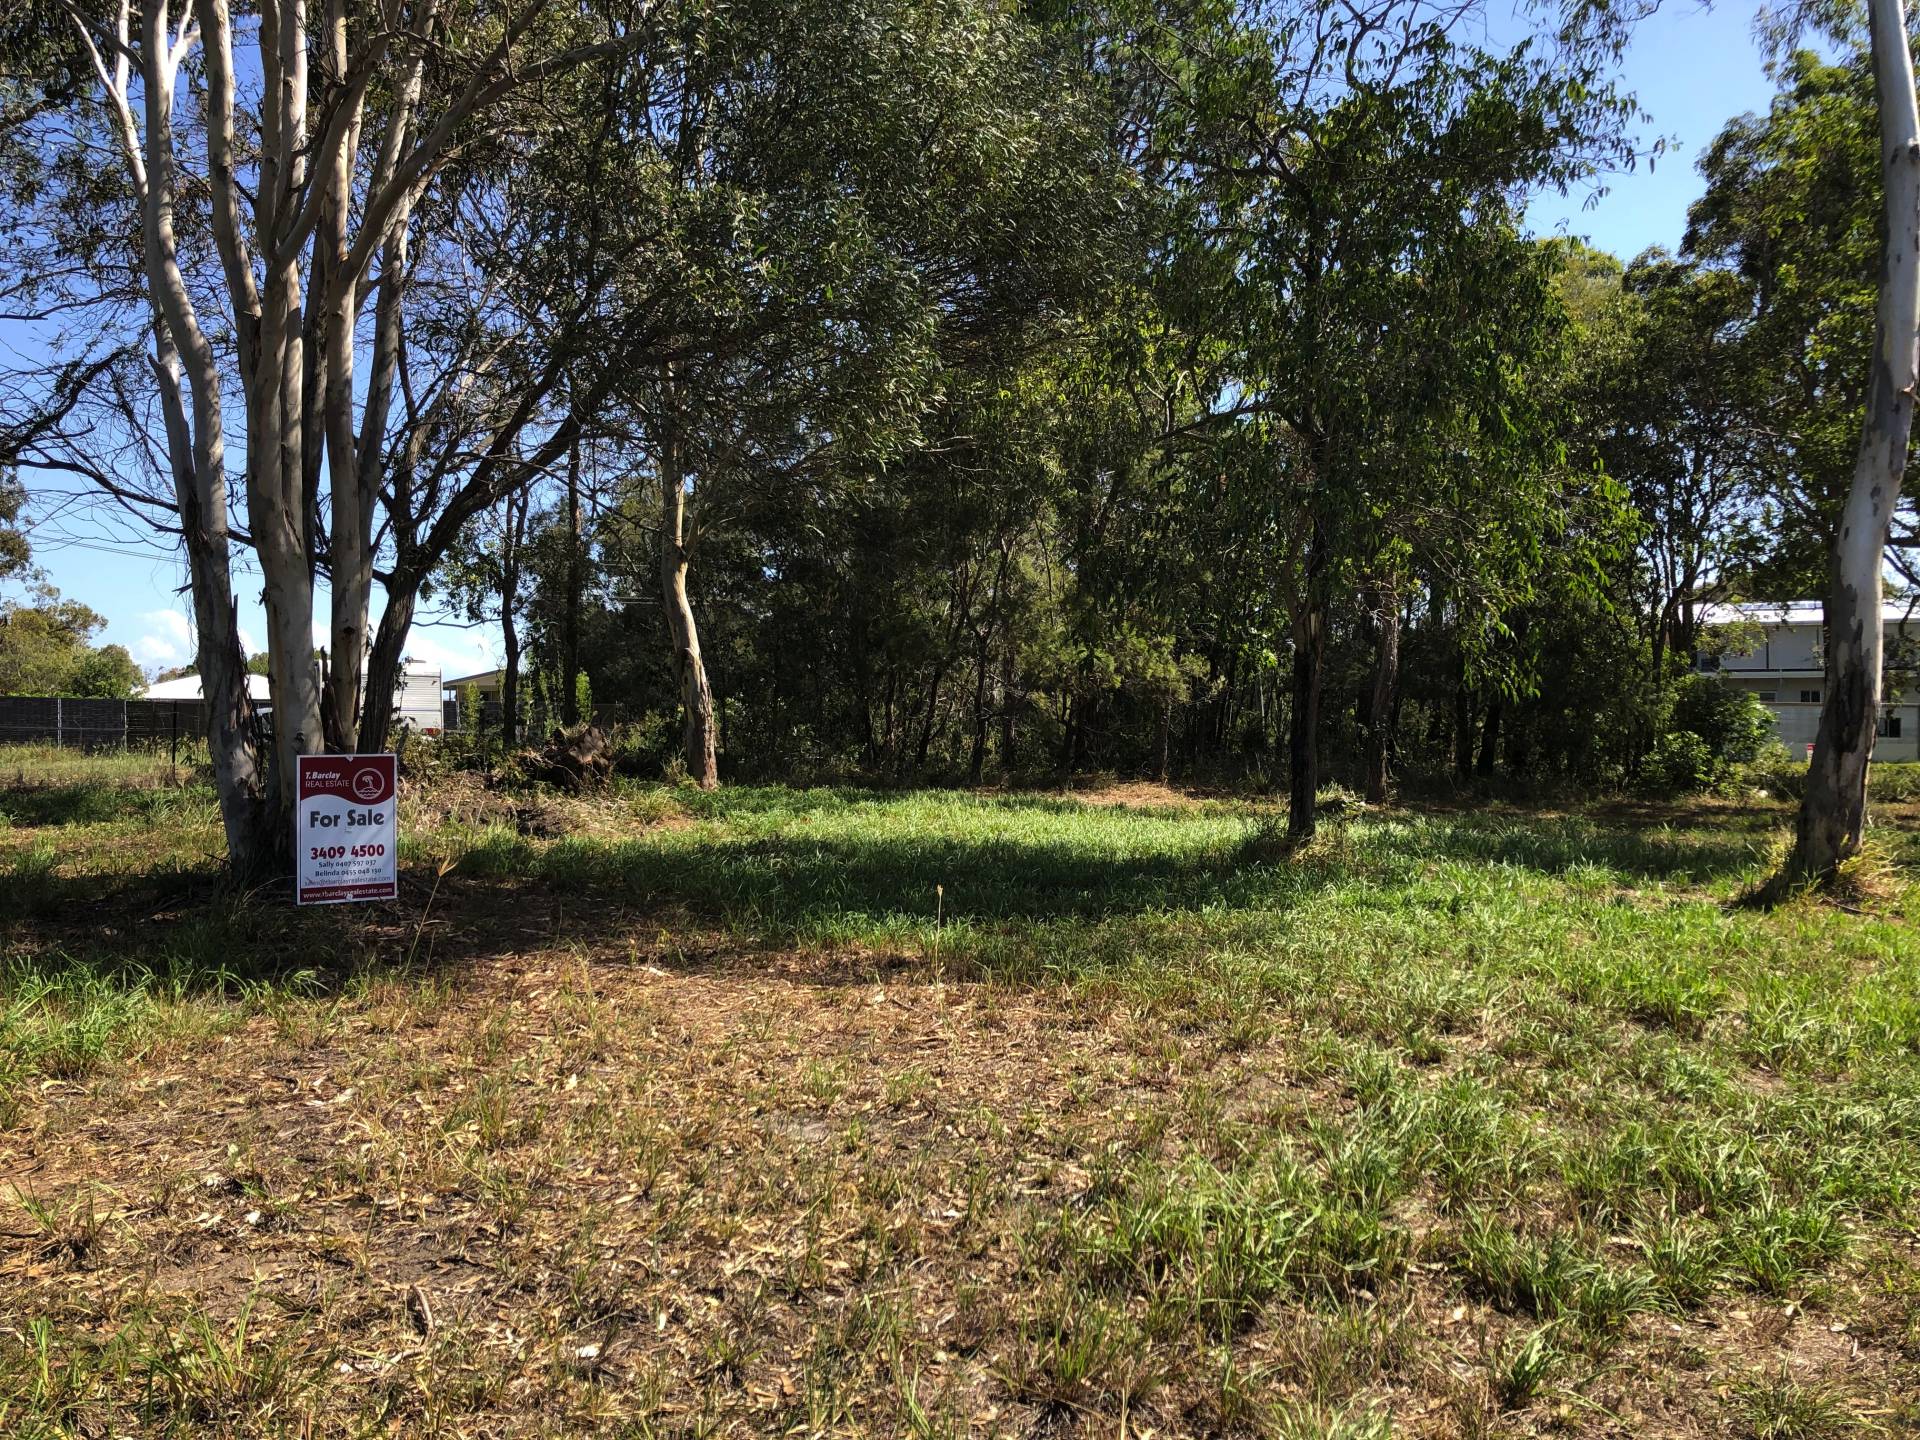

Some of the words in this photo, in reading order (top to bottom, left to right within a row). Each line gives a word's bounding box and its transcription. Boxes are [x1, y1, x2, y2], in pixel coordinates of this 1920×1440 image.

[305, 780, 324, 788] REAL
[326, 779, 350, 787] ESTATE
[310, 811, 341, 828] For
[347, 809, 385, 826] Sale
[310, 846, 345, 860] 3409
[351, 844, 385, 858] 4500
[318, 861, 334, 869] Sally
